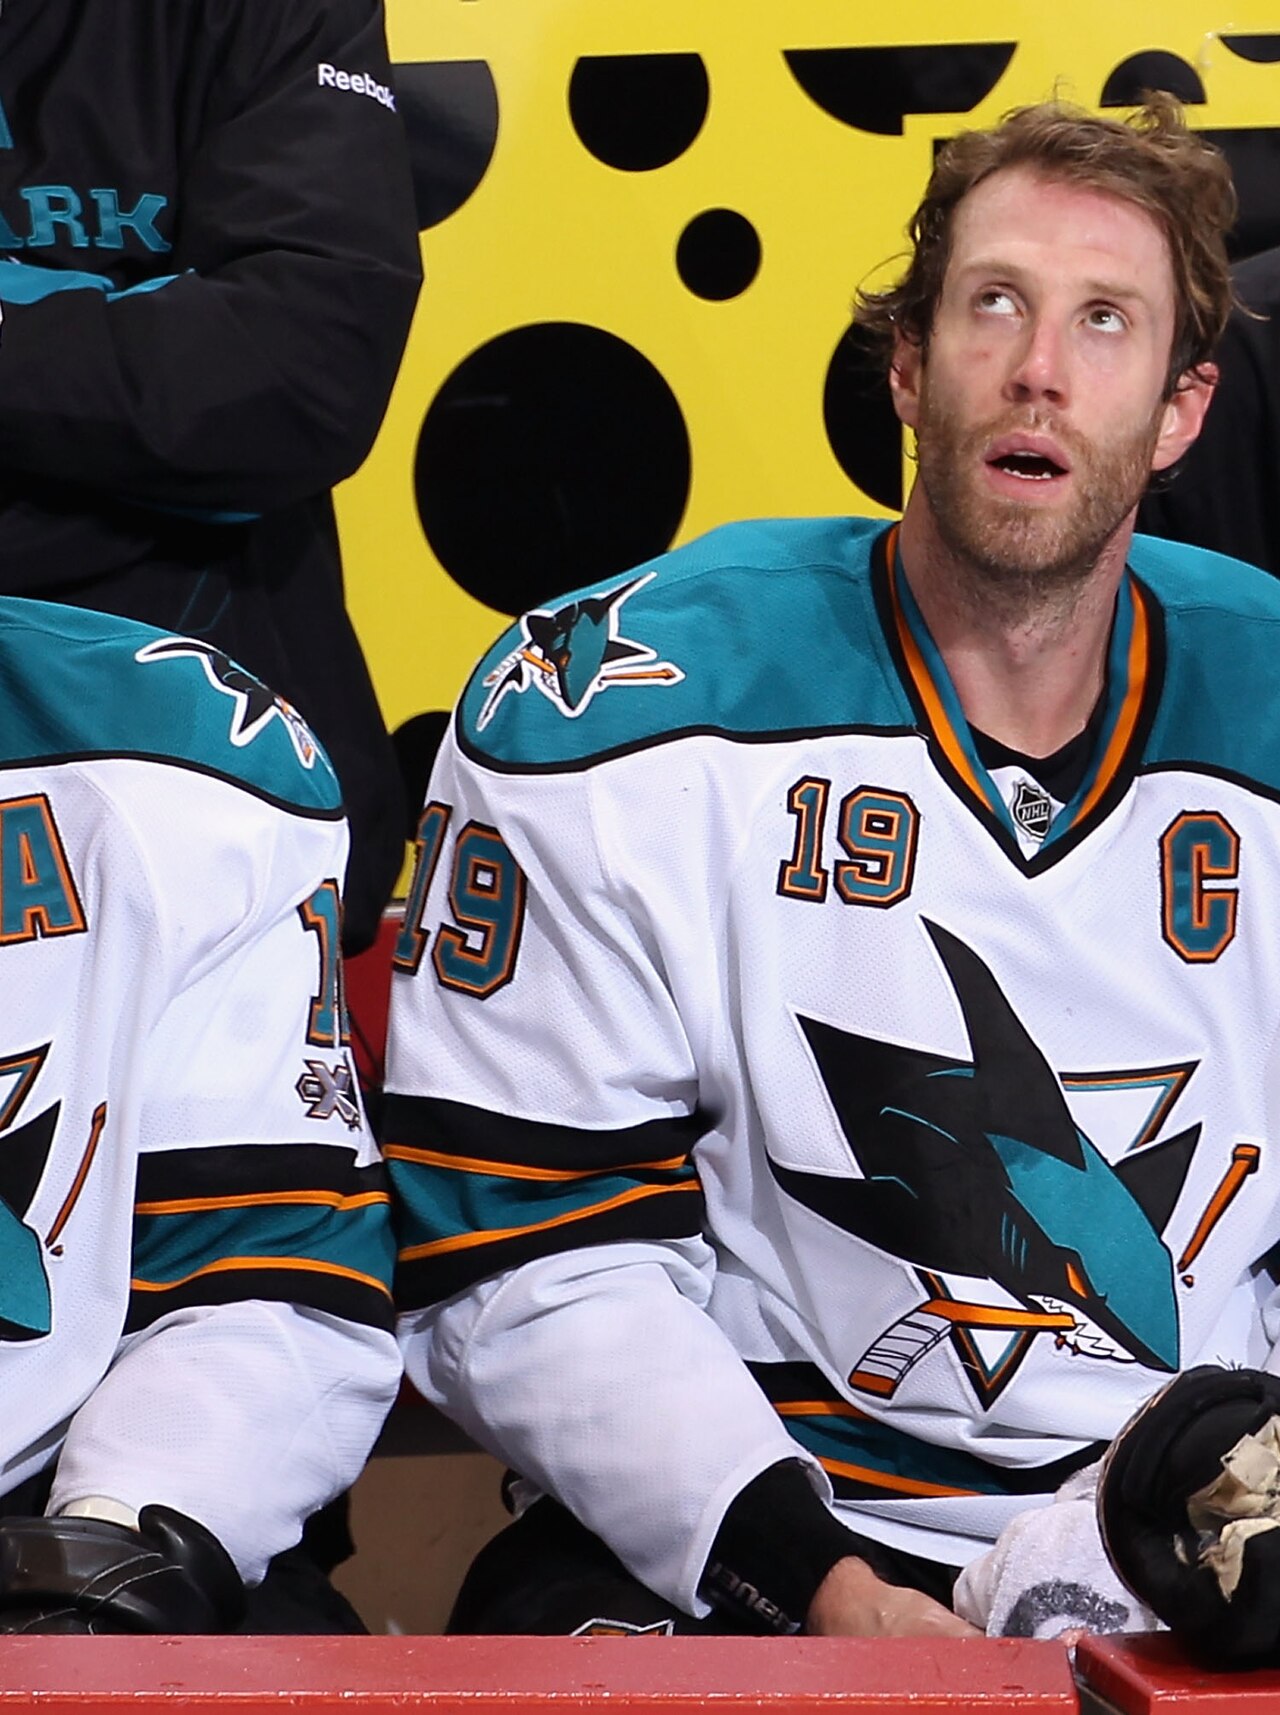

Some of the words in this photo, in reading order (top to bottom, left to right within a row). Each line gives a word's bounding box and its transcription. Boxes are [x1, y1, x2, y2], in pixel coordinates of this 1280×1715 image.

[317, 62, 396, 113] Reebok
[0, 792, 89, 947] A
[776, 774, 921, 909] 19
[1020, 803, 1049, 821] NHL
[392, 800, 528, 1002] 19
[1160, 809, 1240, 965] C
